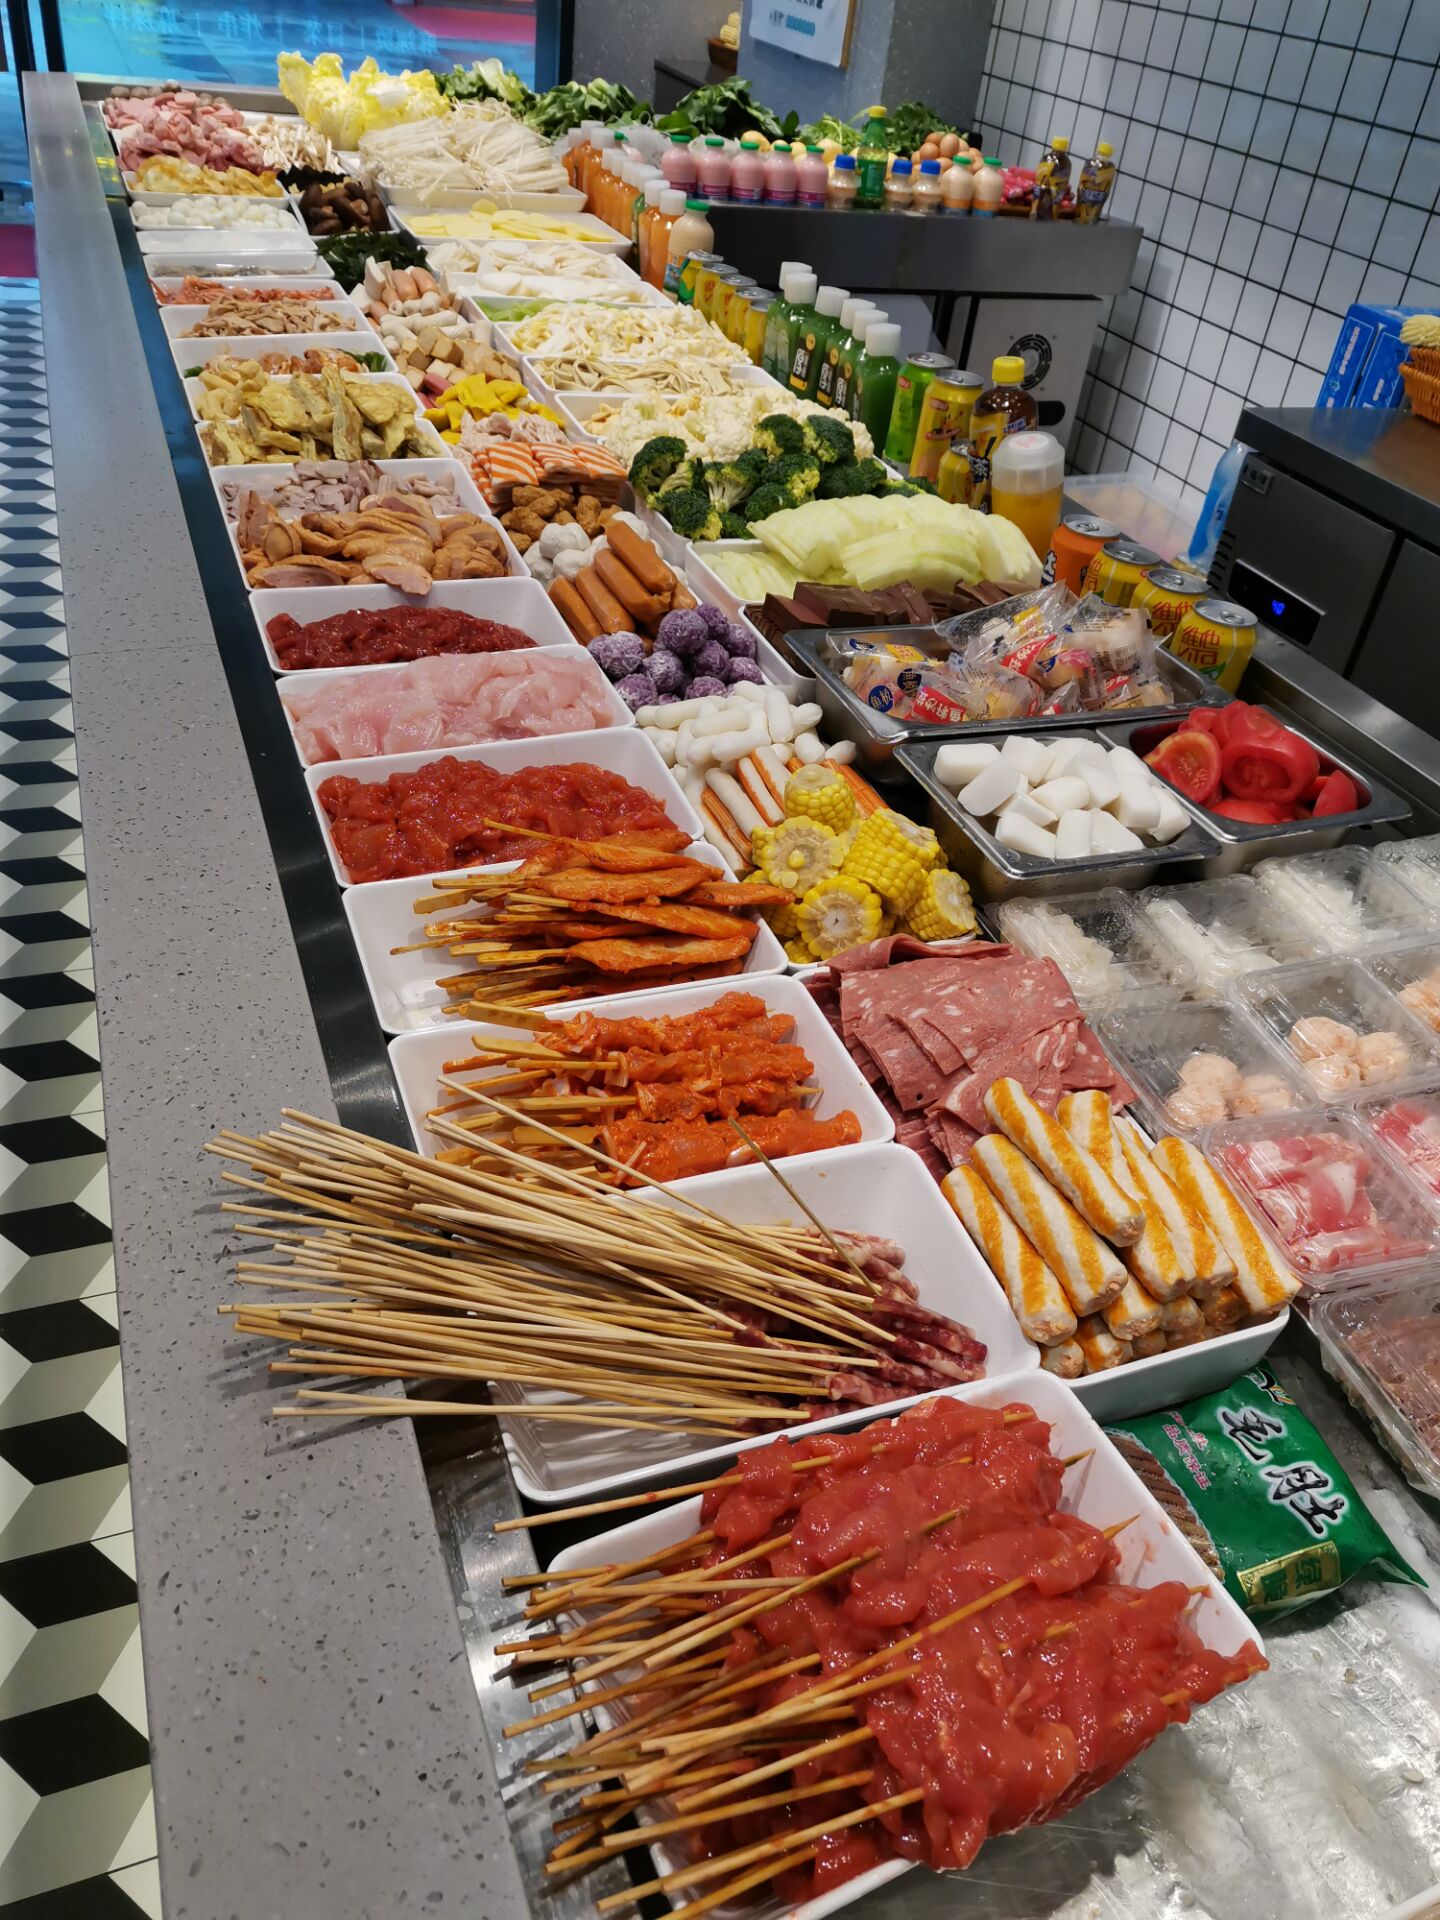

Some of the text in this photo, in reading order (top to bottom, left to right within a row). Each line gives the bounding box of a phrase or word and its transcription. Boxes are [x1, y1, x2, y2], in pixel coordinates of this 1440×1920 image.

[1162, 1424, 1212, 1490] 品质保证
[1219, 1406, 1347, 1537] 毛肚
